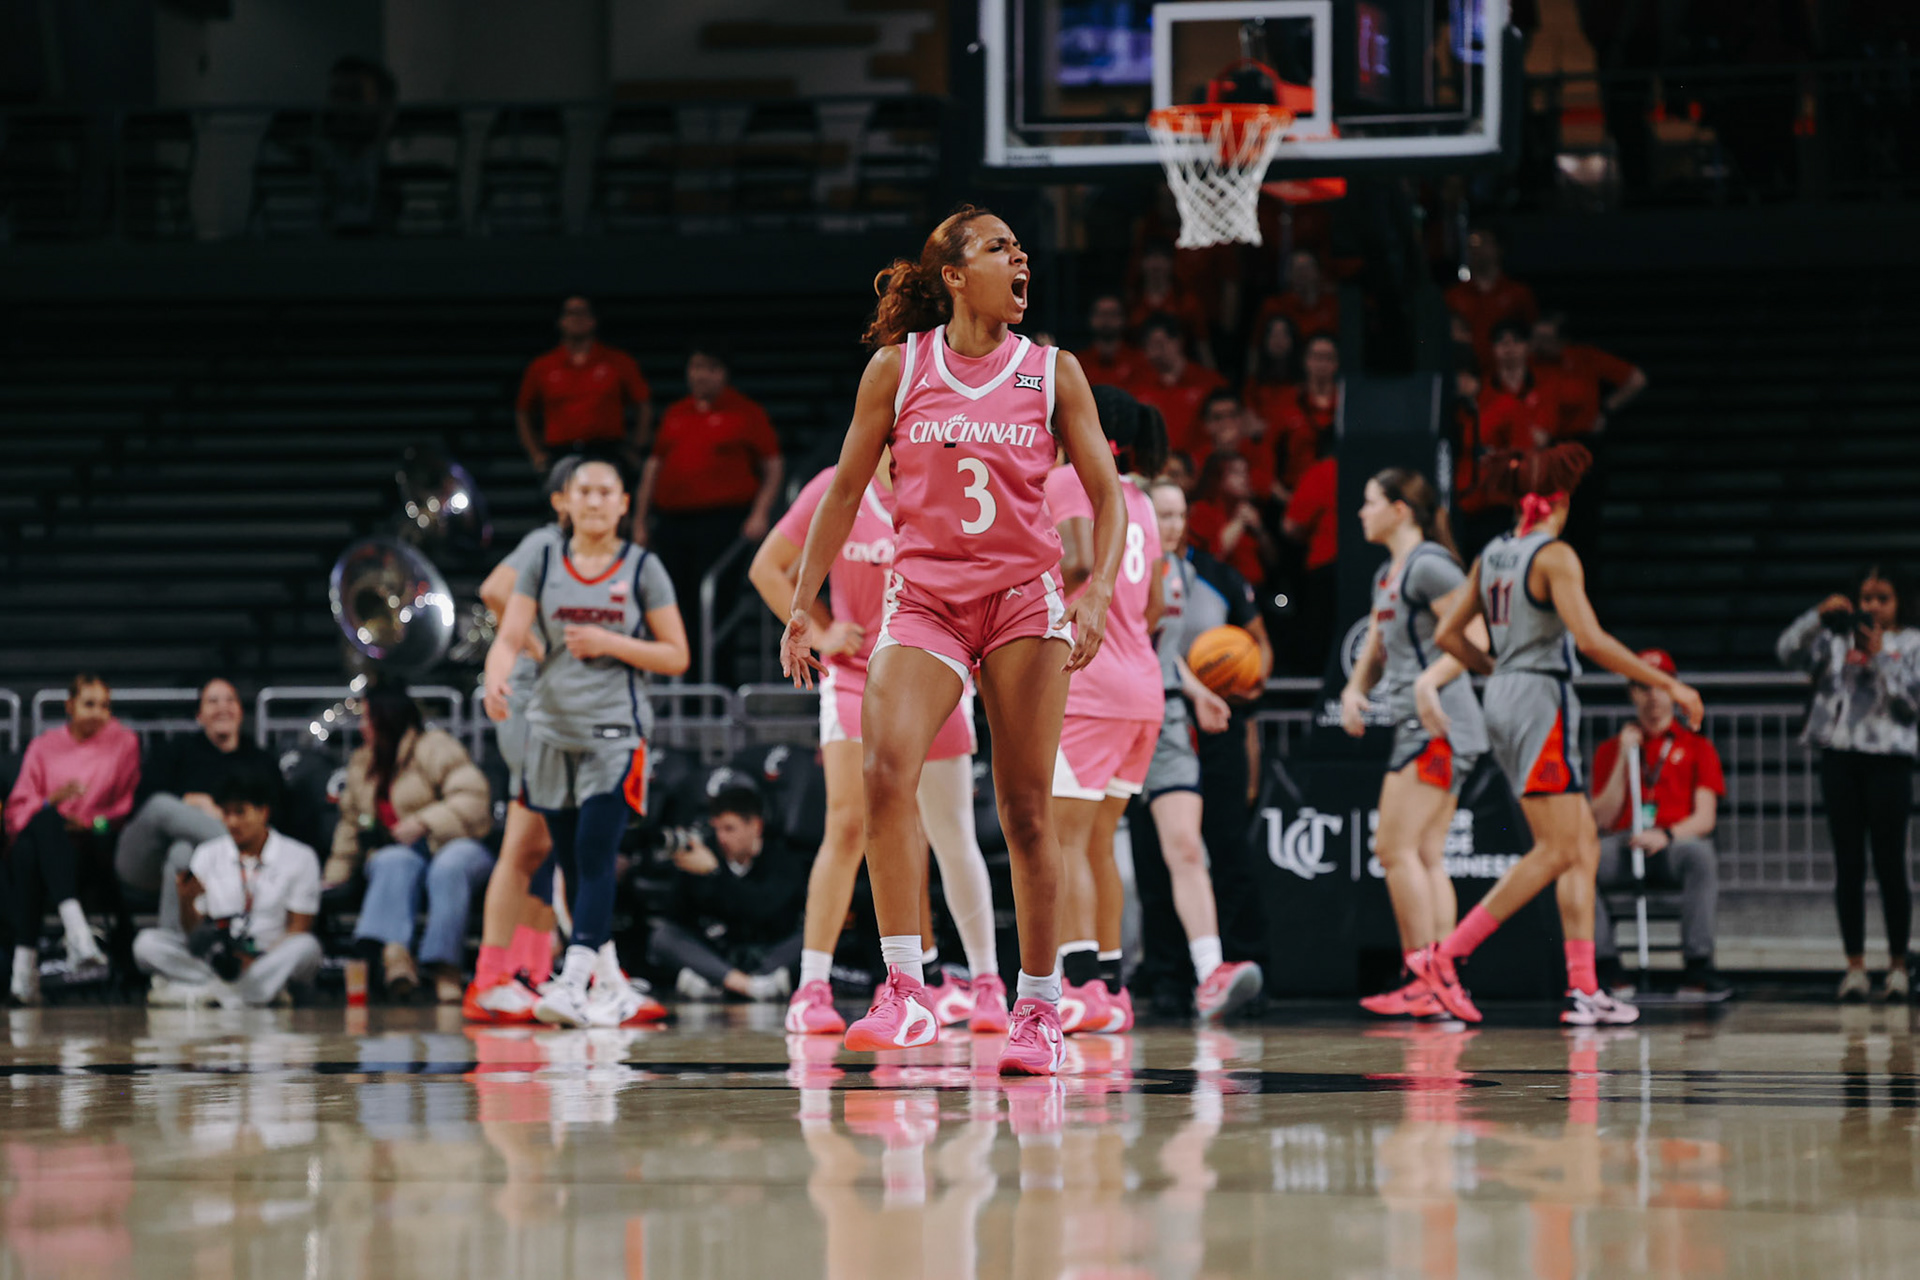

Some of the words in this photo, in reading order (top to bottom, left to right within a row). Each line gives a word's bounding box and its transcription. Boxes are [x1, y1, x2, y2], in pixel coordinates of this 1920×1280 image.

[909, 413, 1037, 448] CINCINNATI
[957, 457, 997, 535] 3
[1487, 578, 1514, 627] 11
[1261, 807, 1343, 880] UC
